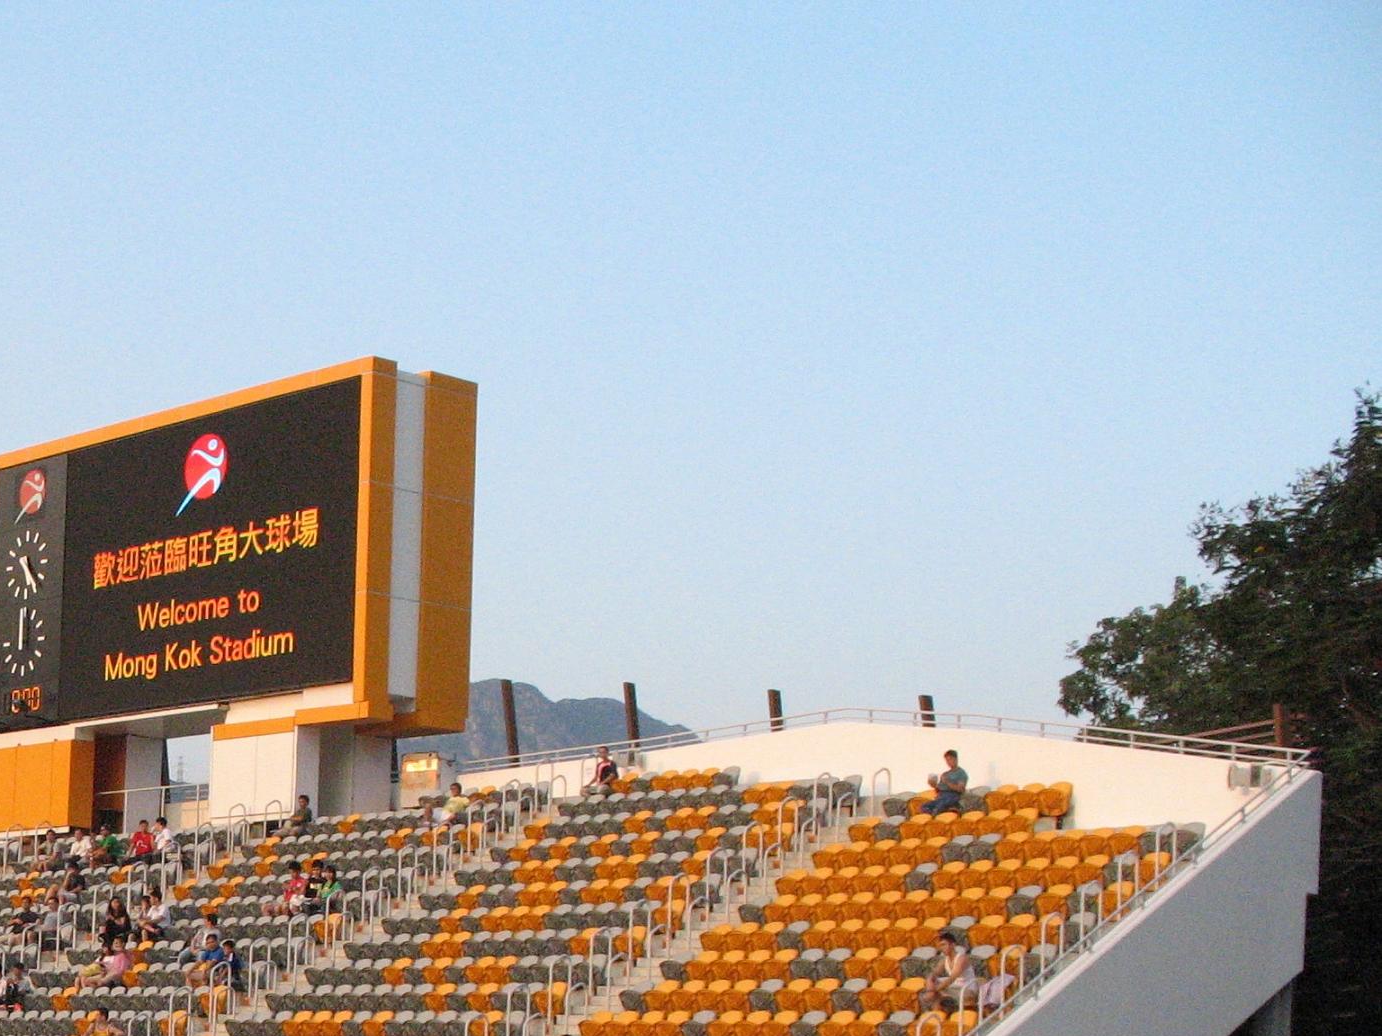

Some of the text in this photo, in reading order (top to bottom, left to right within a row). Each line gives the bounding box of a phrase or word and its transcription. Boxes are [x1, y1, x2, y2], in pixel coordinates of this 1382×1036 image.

[93, 508, 319, 589] 歡迎蒞臨旺角大球場
[138, 589, 261, 631] Welcome to
[104, 629, 294, 681] Mong Kok Stadium
